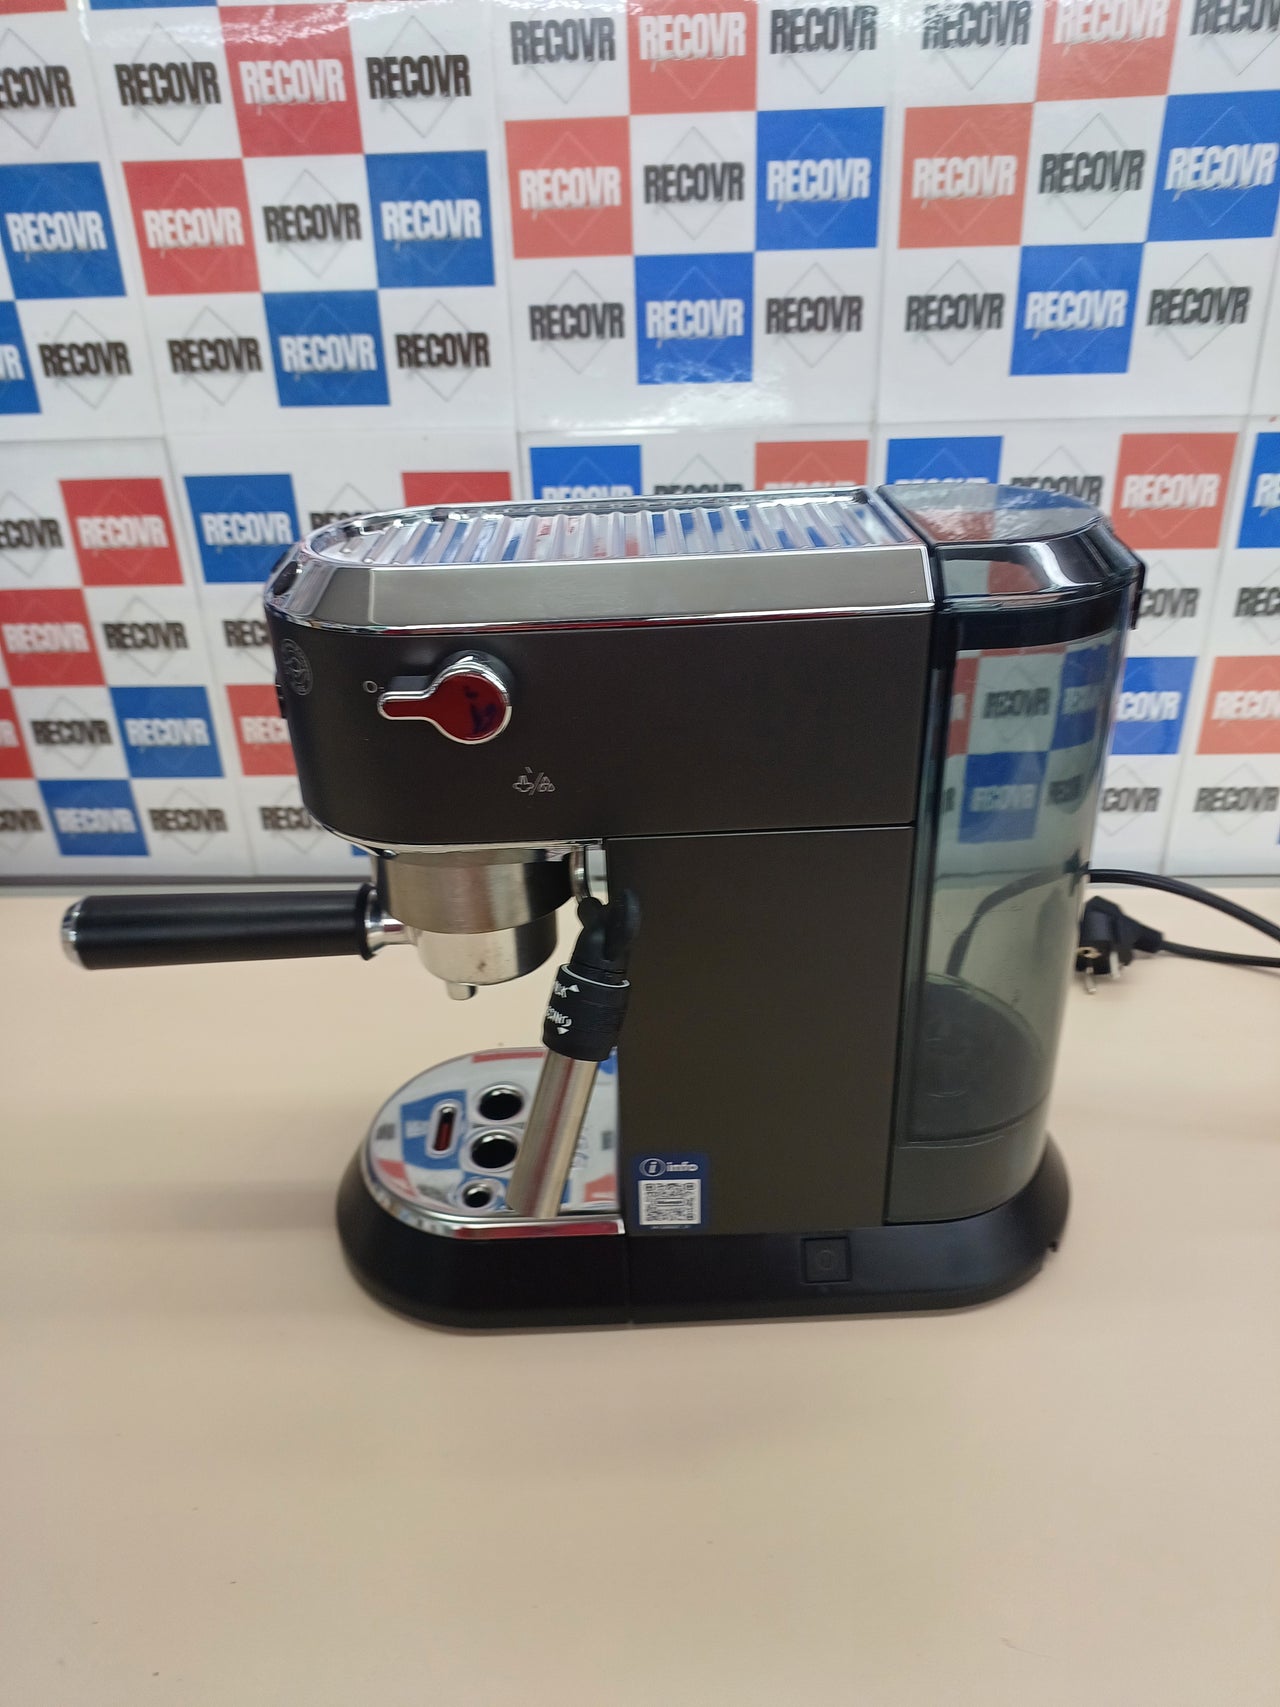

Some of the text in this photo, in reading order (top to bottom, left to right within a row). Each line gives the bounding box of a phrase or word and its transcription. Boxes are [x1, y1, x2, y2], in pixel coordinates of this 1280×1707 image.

[510, 17, 616, 66] RECOVR
[639, 11, 747, 61] RECOVR
[769, 5, 878, 54] RECOVR
[921, 0, 1032, 51] RECOVR
[1053, 0, 1170, 45] RECOVR
[0, 65, 76, 107] COVR
[114, 61, 222, 106] RECOVR
[239, 59, 347, 104] RECOVR
[366, 54, 472, 99] RECOVR
[644, 162, 745, 204] RECOVR
[766, 158, 871, 200] RECOVR
[912, 155, 1018, 200] RECOVR
[1039, 149, 1147, 194] RECOVR
[1163, 142, 1280, 191] RECOVR
[519, 166, 622, 210] RECOVR
[5, 211, 107, 252] RECOVR
[142, 207, 245, 249] RECOVR
[263, 203, 362, 243] RECOVR
[381, 199, 482, 241] RECOVR
[530, 302, 625, 341] RECOVR
[645, 299, 744, 339] RECOVR
[765, 295, 863, 334] RECOVR
[905, 293, 1004, 332] RECOVR
[1024, 290, 1129, 330] RECOVR
[1146, 286, 1252, 327] RECOVR
[38, 341, 132, 378] RECOVR
[168, 337, 263, 374] RECOVR
[279, 334, 377, 373] RECOVR
[395, 332, 490, 369] RECOVR
[1120, 473, 1221, 510] RECOVR
[0, 518, 64, 549] COVR
[76, 516, 169, 549] RECOVR
[202, 511, 295, 546] RECOVR
[1140, 587, 1200, 618] COVR
[1233, 586, 1280, 617] REC
[2, 622, 91, 654] RECOVR
[102, 622, 189, 651] RECOVR
[222, 620, 272, 647] REC
[1116, 691, 1182, 721] COVR
[30, 719, 113, 746] RECOVR
[124, 717, 211, 746] RECOVR
[1101, 787, 1161, 813] COVR
[150, 808, 227, 833] RECOVR
